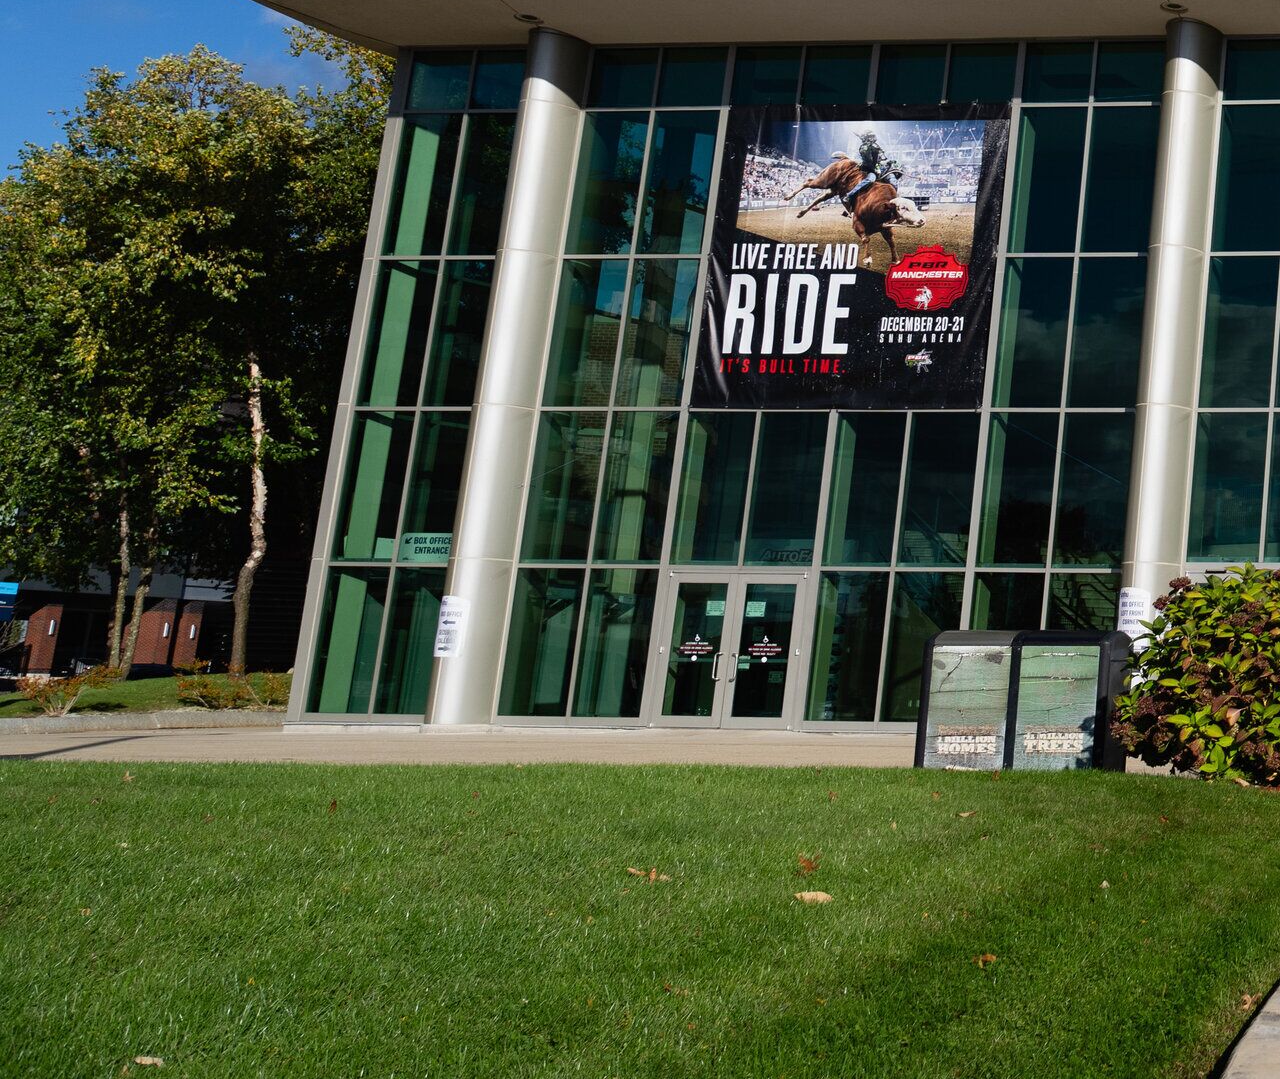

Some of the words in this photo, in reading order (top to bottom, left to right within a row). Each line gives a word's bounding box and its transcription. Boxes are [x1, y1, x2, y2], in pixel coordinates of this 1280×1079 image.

[732, 244, 769, 269] LIVE
[773, 244, 816, 269] FREE
[820, 244, 859, 269] AND
[722, 274, 856, 354] RIDE
[881, 317, 932, 332] DECEMBER
[935, 316, 964, 332] 20-21
[880, 333, 912, 343] SNHU
[922, 333, 962, 343] ARENA
[720, 359, 750, 373] IT'S
[759, 359, 795, 373] BULL
[803, 359, 846, 373] TIME.
[937, 743, 996, 754] HOMES
[1024, 740, 1083, 752] TREES
